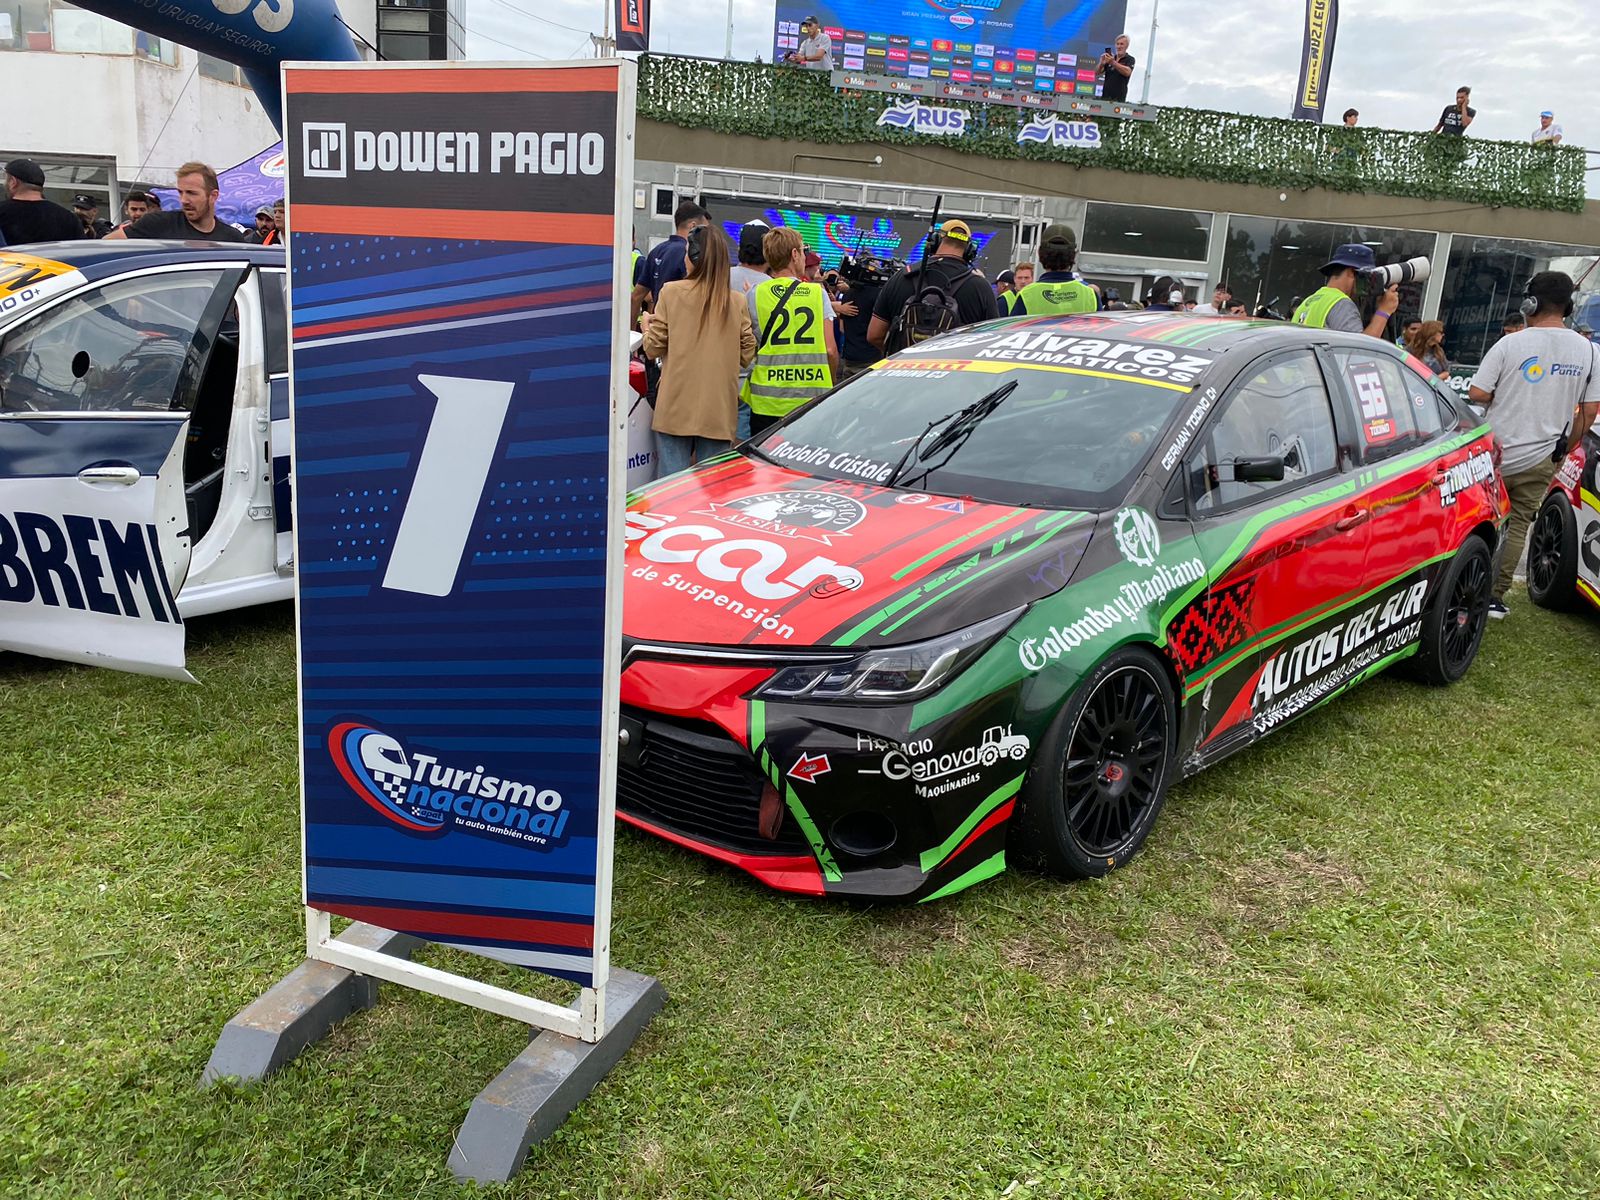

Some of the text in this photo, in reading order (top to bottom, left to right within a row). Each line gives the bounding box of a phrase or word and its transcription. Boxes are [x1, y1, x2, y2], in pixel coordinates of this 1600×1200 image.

[158, 4, 222, 36] URUGUAY
[220, 28, 277, 56] SEGUROS
[917, 108, 962, 129] RUS
[1054, 123, 1098, 141] RUS
[354, 130, 605, 175] DOWEN PAGIO
[770, 306, 815, 345] 22
[974, 348, 1192, 384] NEUMATICOS
[994, 331, 1213, 374] Alvarez
[767, 368, 824, 381] PRENSA
[769, 441, 830, 468] Rodolfo
[1161, 427, 1192, 472] GERMAN
[383, 374, 515, 596] 1
[724, 512, 798, 537] ALSINA
[632, 564, 796, 640] de Suspensión
[1018, 603, 1122, 671] Colombo
[1119, 556, 1208, 611] Magliano
[1250, 579, 1429, 710] AUTOS DEL SUR
[1382, 620, 1422, 654] TOYOTA
[412, 753, 562, 811] Turismo
[882, 746, 976, 780] Genova
[406, 783, 570, 838] nacional
[420, 810, 444, 821] apat
[455, 816, 546, 845] tu auto también corre
